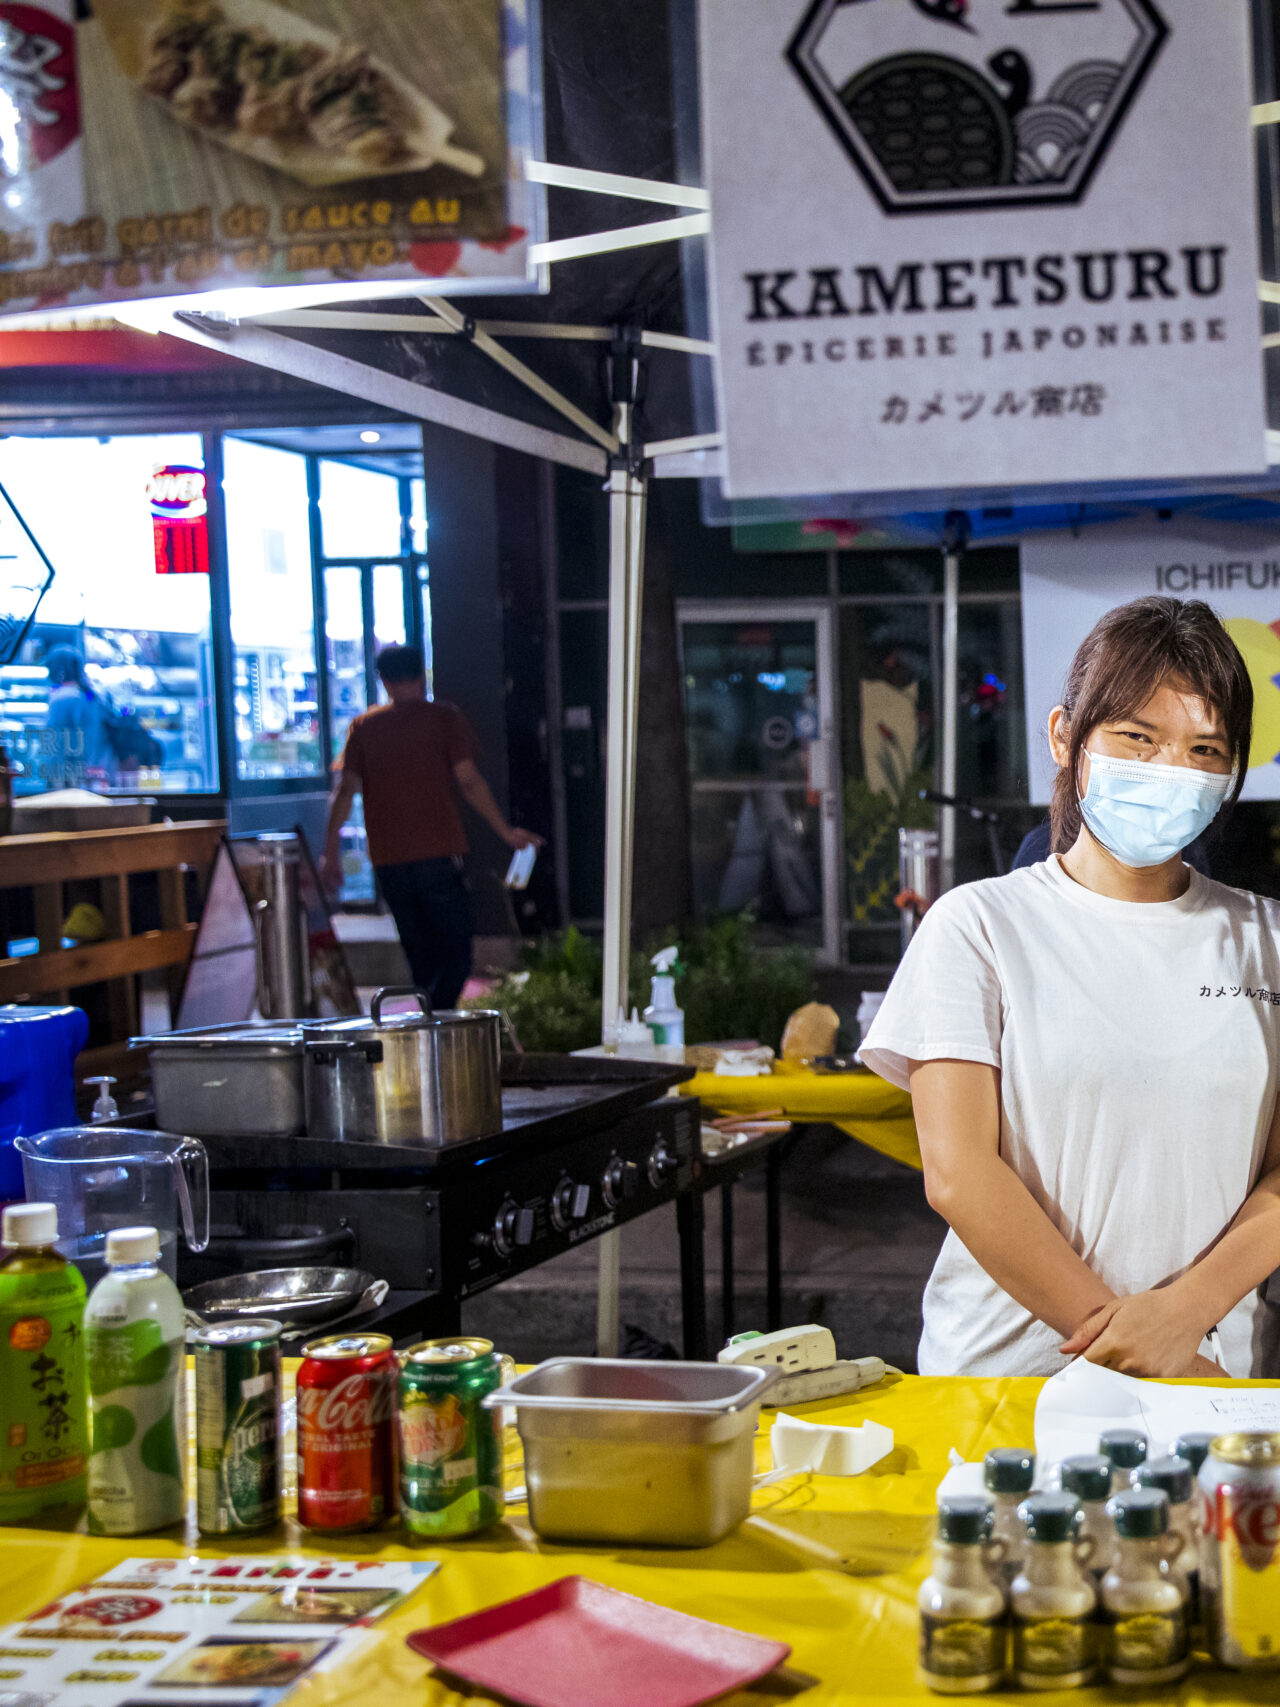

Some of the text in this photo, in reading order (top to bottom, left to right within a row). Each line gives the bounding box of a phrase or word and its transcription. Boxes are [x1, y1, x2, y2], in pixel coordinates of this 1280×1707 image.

[743, 246, 1228, 322] KAMETSURU
[746, 318, 1228, 366] ÉPICERIE JAPONAISE
[880, 383, 1107, 424] カメツル商店
